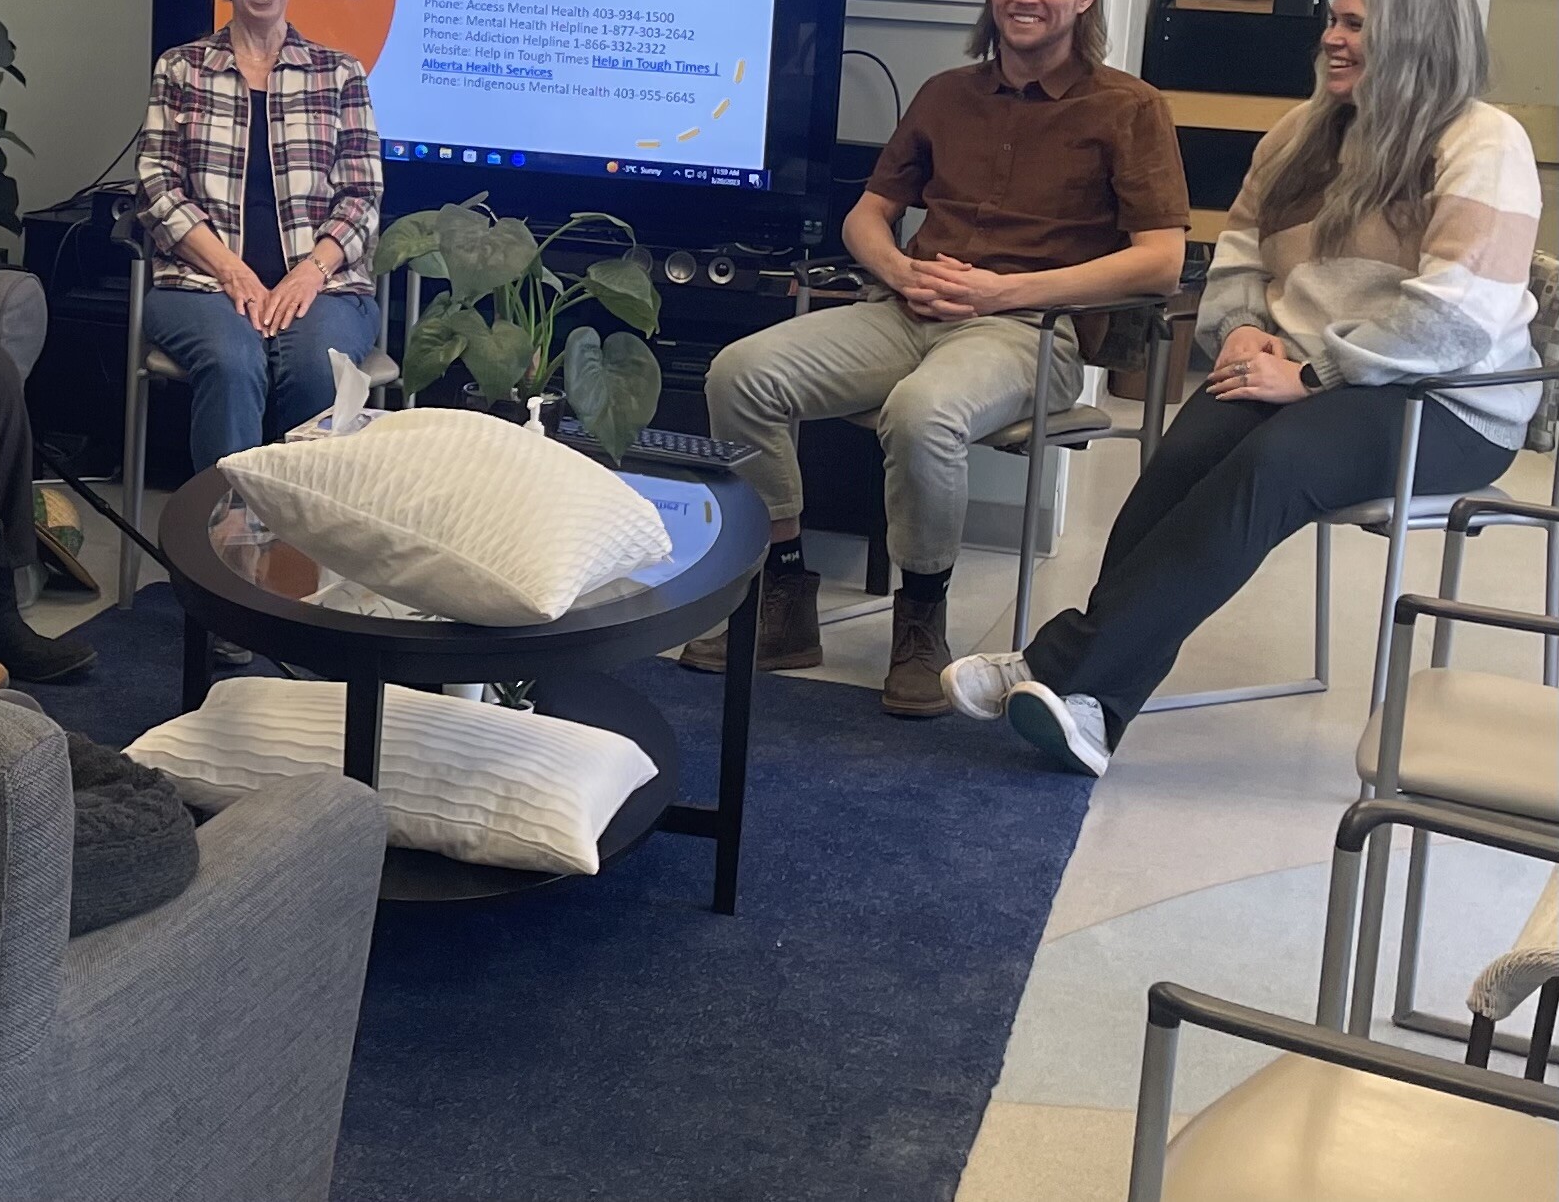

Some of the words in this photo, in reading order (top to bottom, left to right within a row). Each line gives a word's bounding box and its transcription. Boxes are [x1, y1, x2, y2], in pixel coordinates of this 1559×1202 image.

[465, 0, 505, 13] Access
[507, 2, 549, 16] Mental
[551, 5, 590, 18] Health
[592, 7, 675, 23] 403-934-1500
[423, 12, 462, 26] Phone:
[466, 15, 506, 29] Mental
[509, 18, 547, 31] Health
[550, 20, 599, 36] Helpline
[601, 24, 695, 41] 1-877-303-2642
[423, 27, 462, 41] Phone:
[464, 30, 520, 44] Addiction
[522, 33, 570, 49] Helpline
[573, 37, 666, 53] 1-866-332-2322
[421, 58, 463, 72] Alberta
[466, 61, 503, 75] Health
[506, 64, 553, 78] Services
[475, 46, 501, 61] Help
[503, 48, 515, 60] in
[517, 49, 552, 64] Tough
[554, 51, 589, 65] Times
[592, 54, 620, 69] Help
[622, 56, 633, 68] in
[635, 57, 672, 72] Tough
[674, 60, 710, 73] Times
[421, 74, 460, 88] Phone:
[463, 77, 526, 94] Indigenous
[528, 81, 570, 95] Mental
[572, 84, 610, 98] Health
